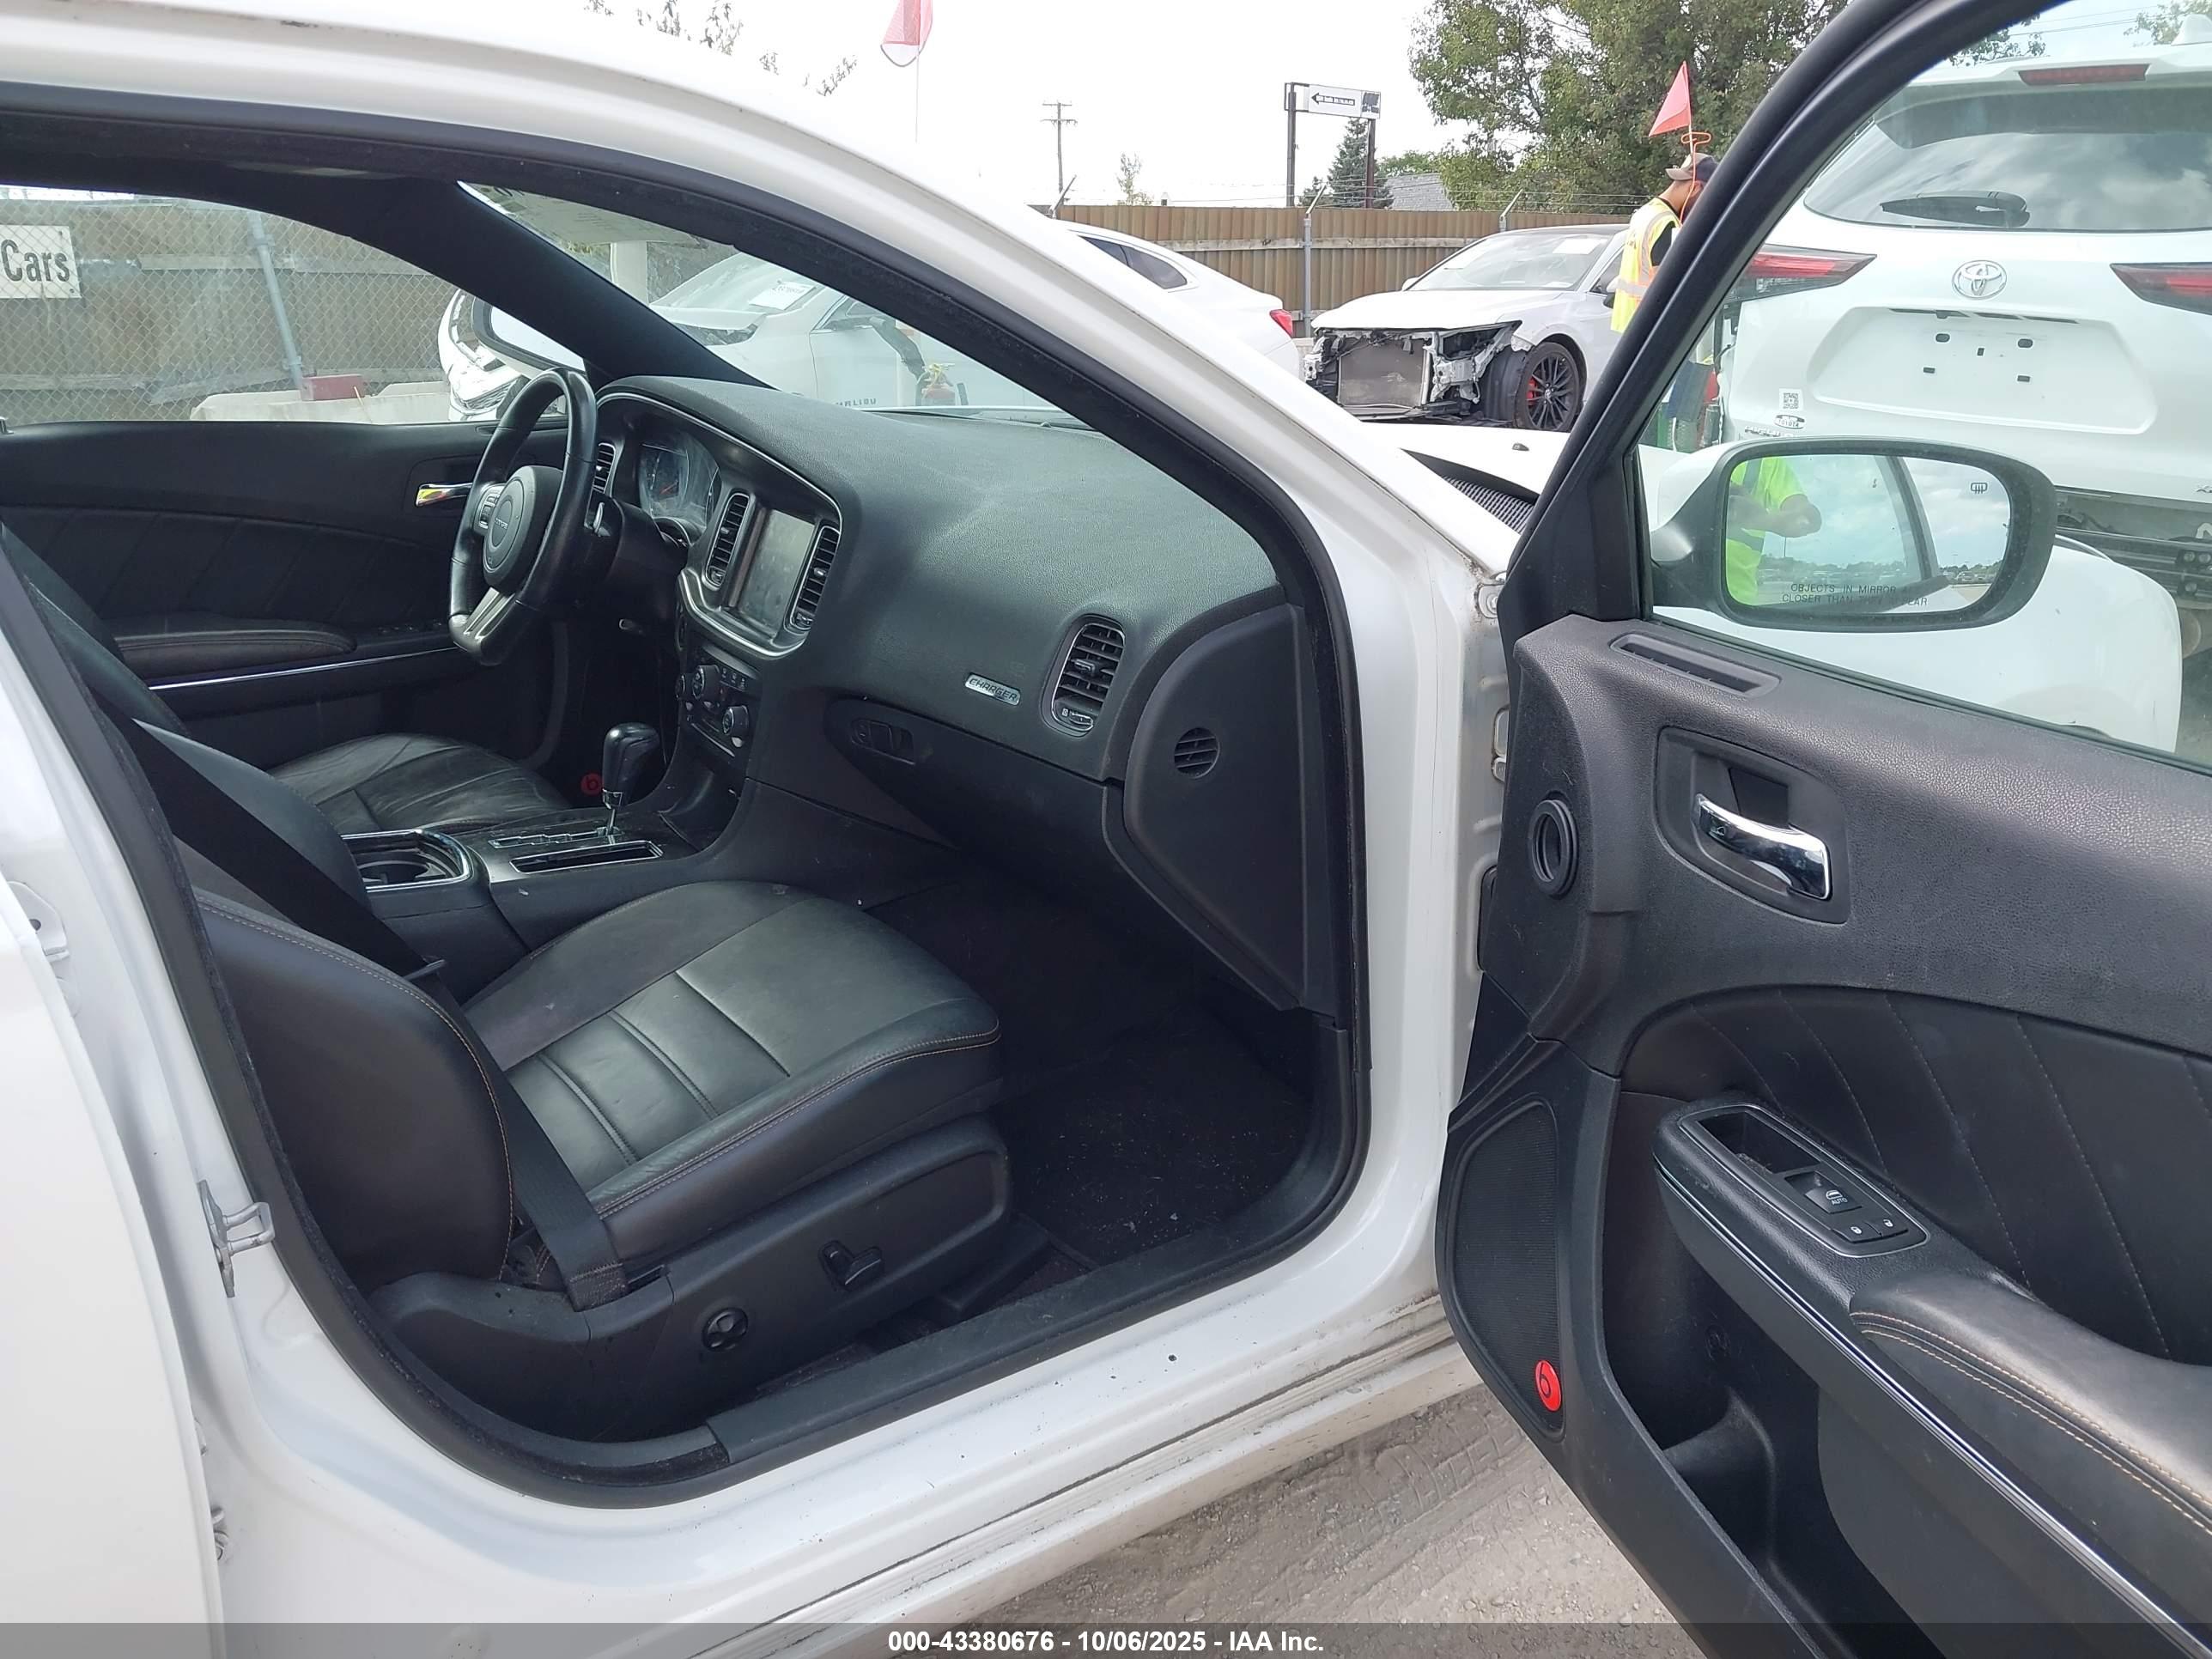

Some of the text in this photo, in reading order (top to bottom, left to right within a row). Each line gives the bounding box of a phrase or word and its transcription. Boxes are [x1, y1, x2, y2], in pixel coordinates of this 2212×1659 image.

[1, 239, 70, 283] Cars
[1790, 583, 1835, 592] OBJECTS
[1843, 585, 1853, 593] IN
[1858, 585, 1897, 594] MIRROR
[1782, 593, 1821, 603] CLOSER
[1827, 595, 1853, 605] THAN
[968, 677, 1018, 702] CHARGER
[1831, 1197, 1849, 1206] AUTO
